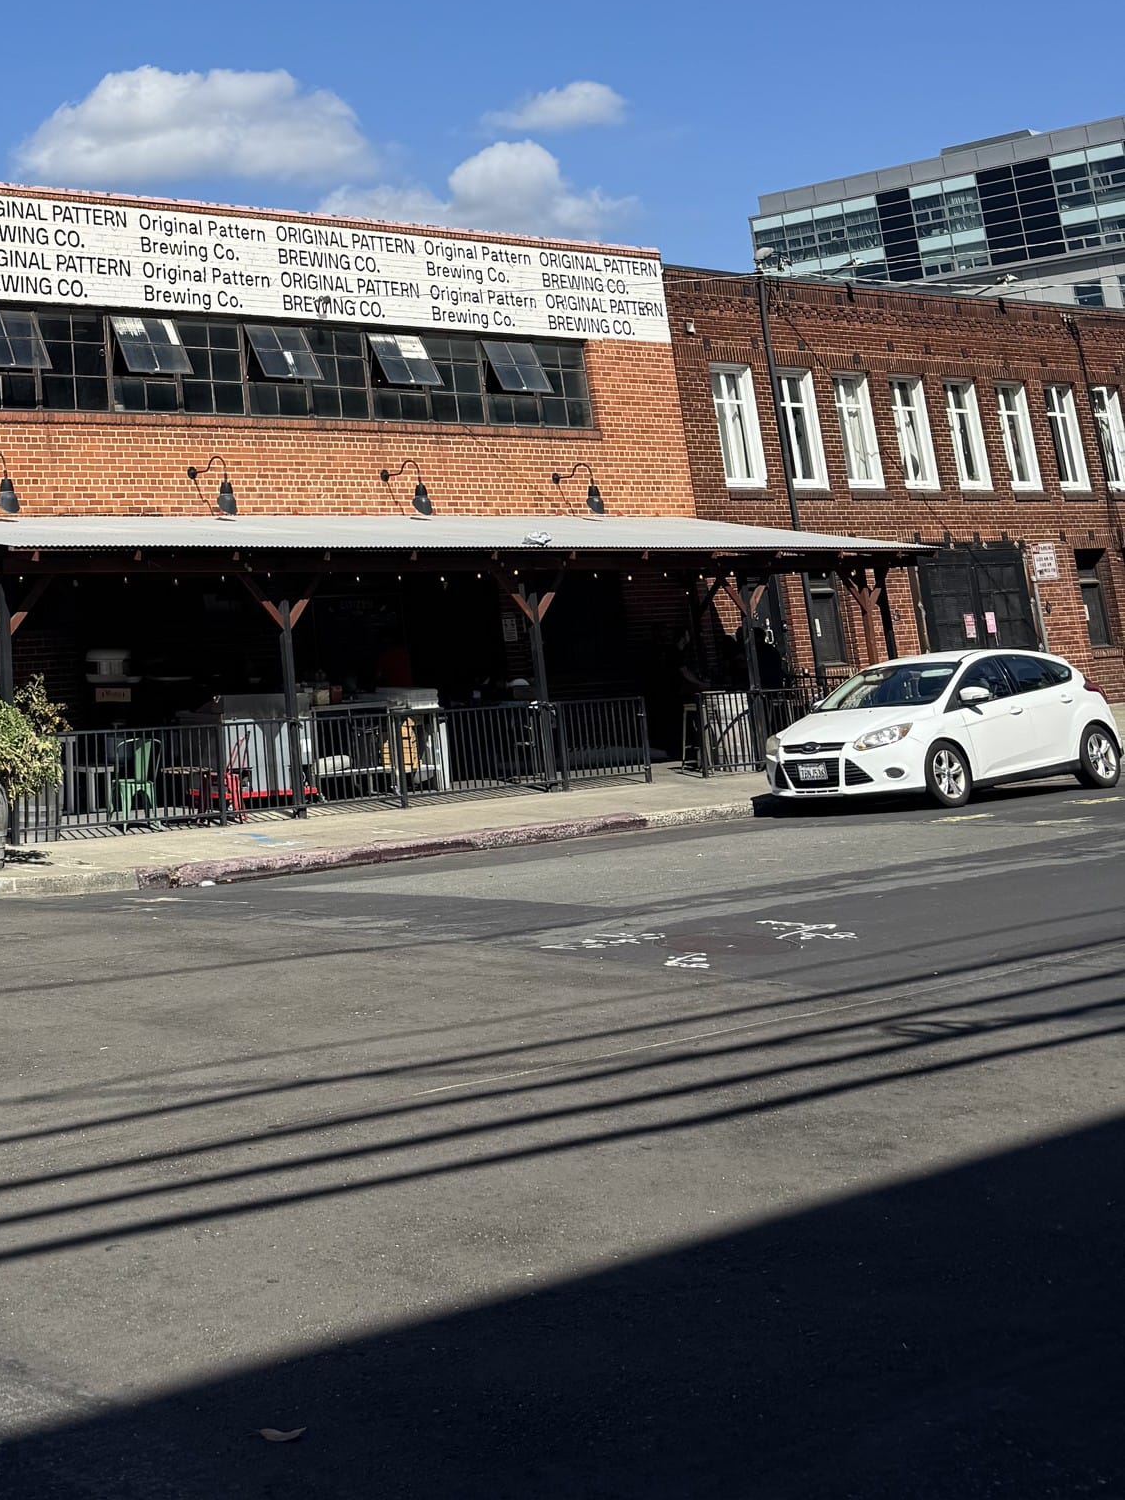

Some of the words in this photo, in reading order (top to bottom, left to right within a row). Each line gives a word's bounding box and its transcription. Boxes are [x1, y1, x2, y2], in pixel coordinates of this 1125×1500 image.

[52, 205, 126, 228] PATTERN
[139, 214, 202, 236] Original
[208, 221, 265, 242] Pattern
[54, 229, 84, 248] CO.
[140, 237, 207, 262] Brewing
[213, 244, 239, 261] Co.
[276, 226, 349, 247] ORIGINAL
[352, 233, 414, 254] PATTERN
[278, 249, 351, 270] BREWING
[355, 256, 379, 273] CO.
[424, 240, 477, 261] Original
[482, 246, 531, 266] Pattern
[539, 252, 602, 272] ORIGINAL
[604, 259, 657, 277] PATTERN
[56, 255, 130, 277] PATTERN
[143, 262, 206, 284] Original
[212, 268, 270, 287] Pattern
[426, 261, 483, 284] Brewing
[488, 267, 509, 283] Co.
[57, 279, 88, 298] CO.
[281, 272, 353, 292] ORIGINAL
[357, 279, 419, 298] PATTERN
[542, 272, 603, 293] BREWING
[606, 278, 628, 295] CO.
[144, 285, 211, 310] Brewing
[217, 291, 243, 308] Co.
[430, 285, 483, 306] Original
[487, 290, 536, 308] Pattern
[545, 294, 608, 314] ORIGINAL
[610, 300, 663, 317] PATTERN
[360, 301, 385, 319] CO.
[432, 306, 489, 329] Brewing
[493, 311, 515, 327] Co.
[548, 315, 609, 335] BREWING
[613, 320, 635, 336] CO.
